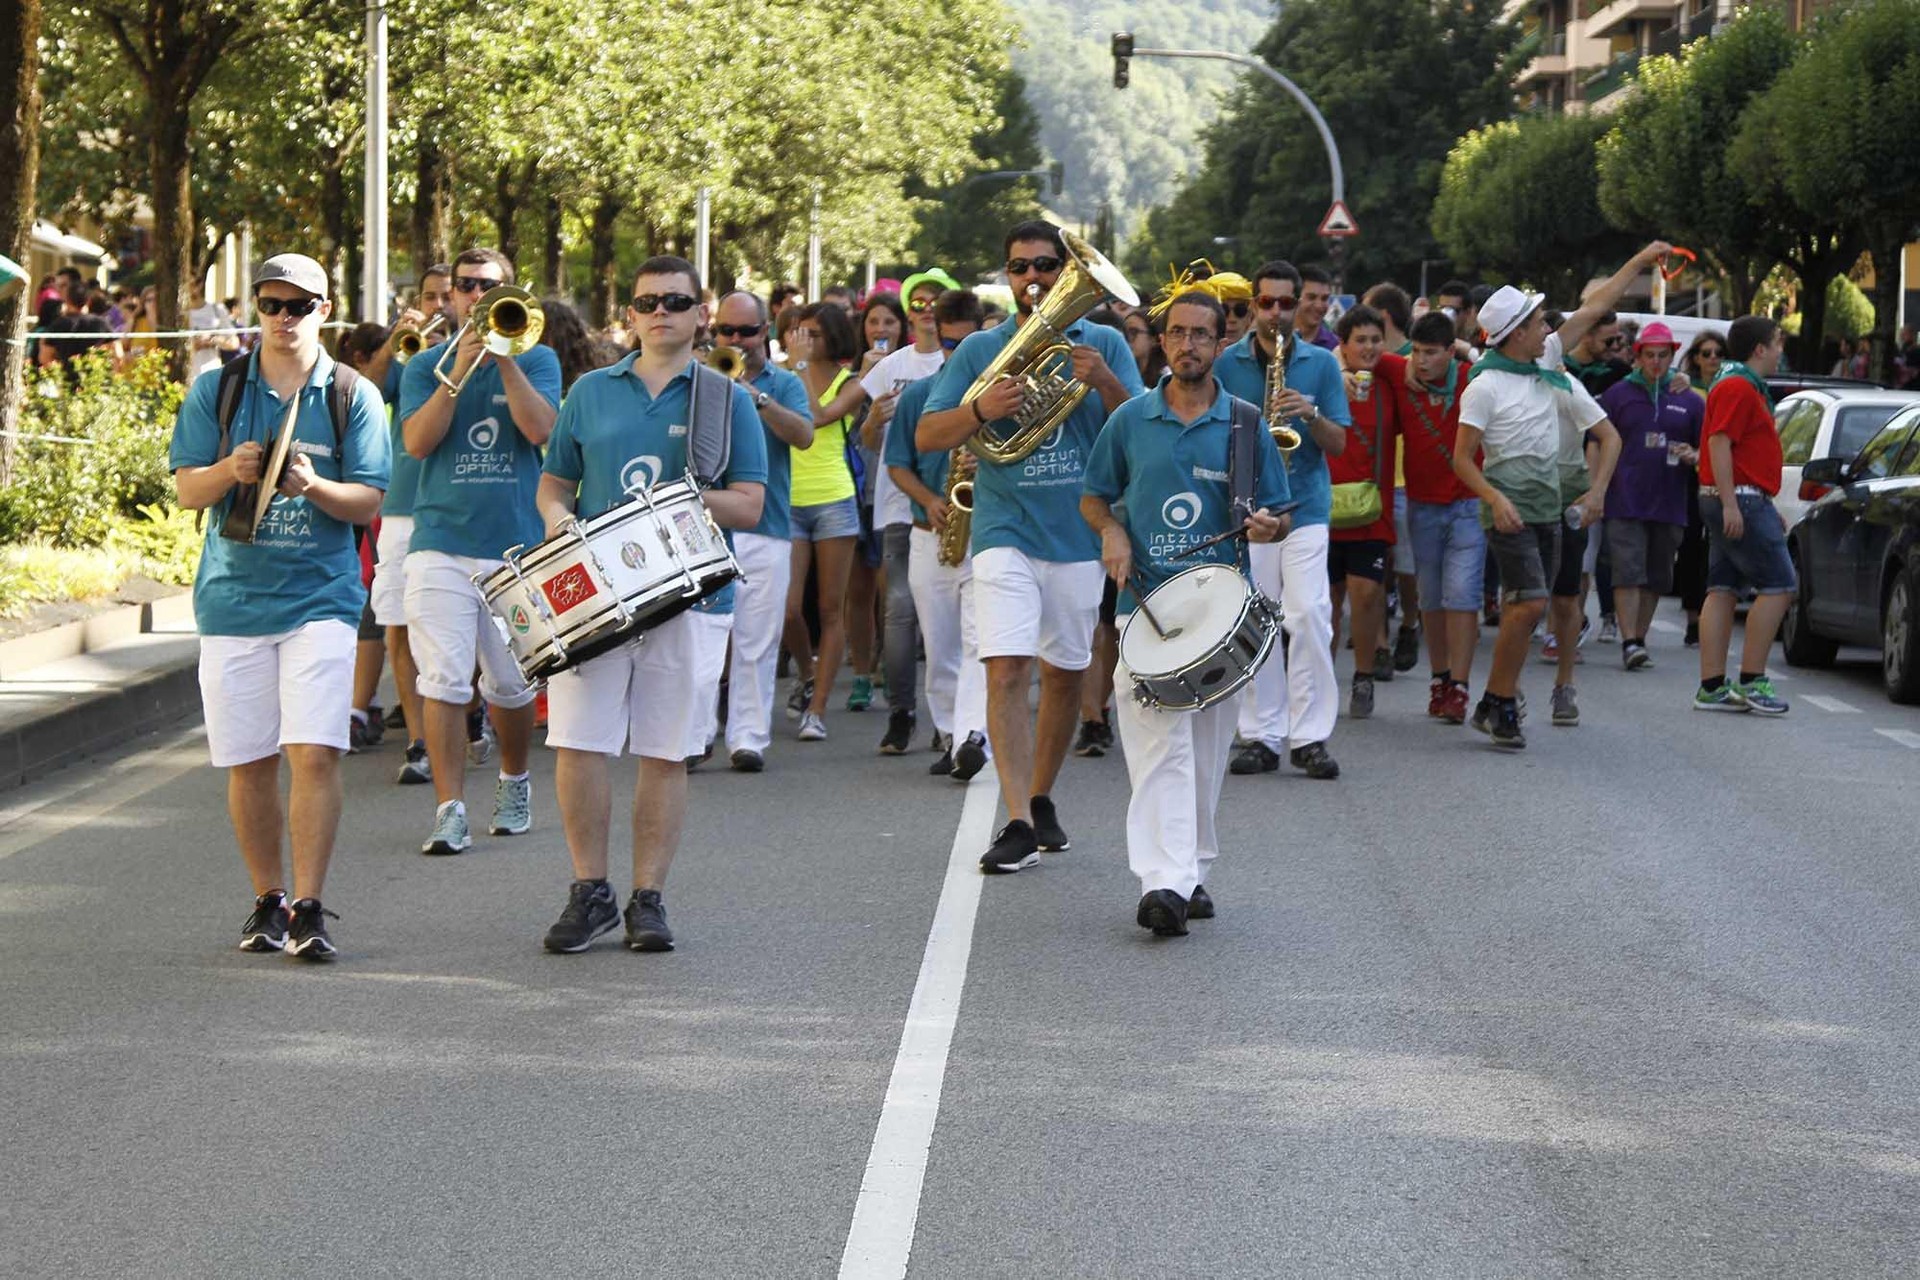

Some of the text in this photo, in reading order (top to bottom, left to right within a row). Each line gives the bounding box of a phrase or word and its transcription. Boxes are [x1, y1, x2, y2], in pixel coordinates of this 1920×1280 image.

[455, 463, 512, 475] OPTIKA
[1024, 460, 1082, 477] OPTIKA
[257, 522, 313, 537] PTIKA
[1149, 533, 1213, 544] intzur
